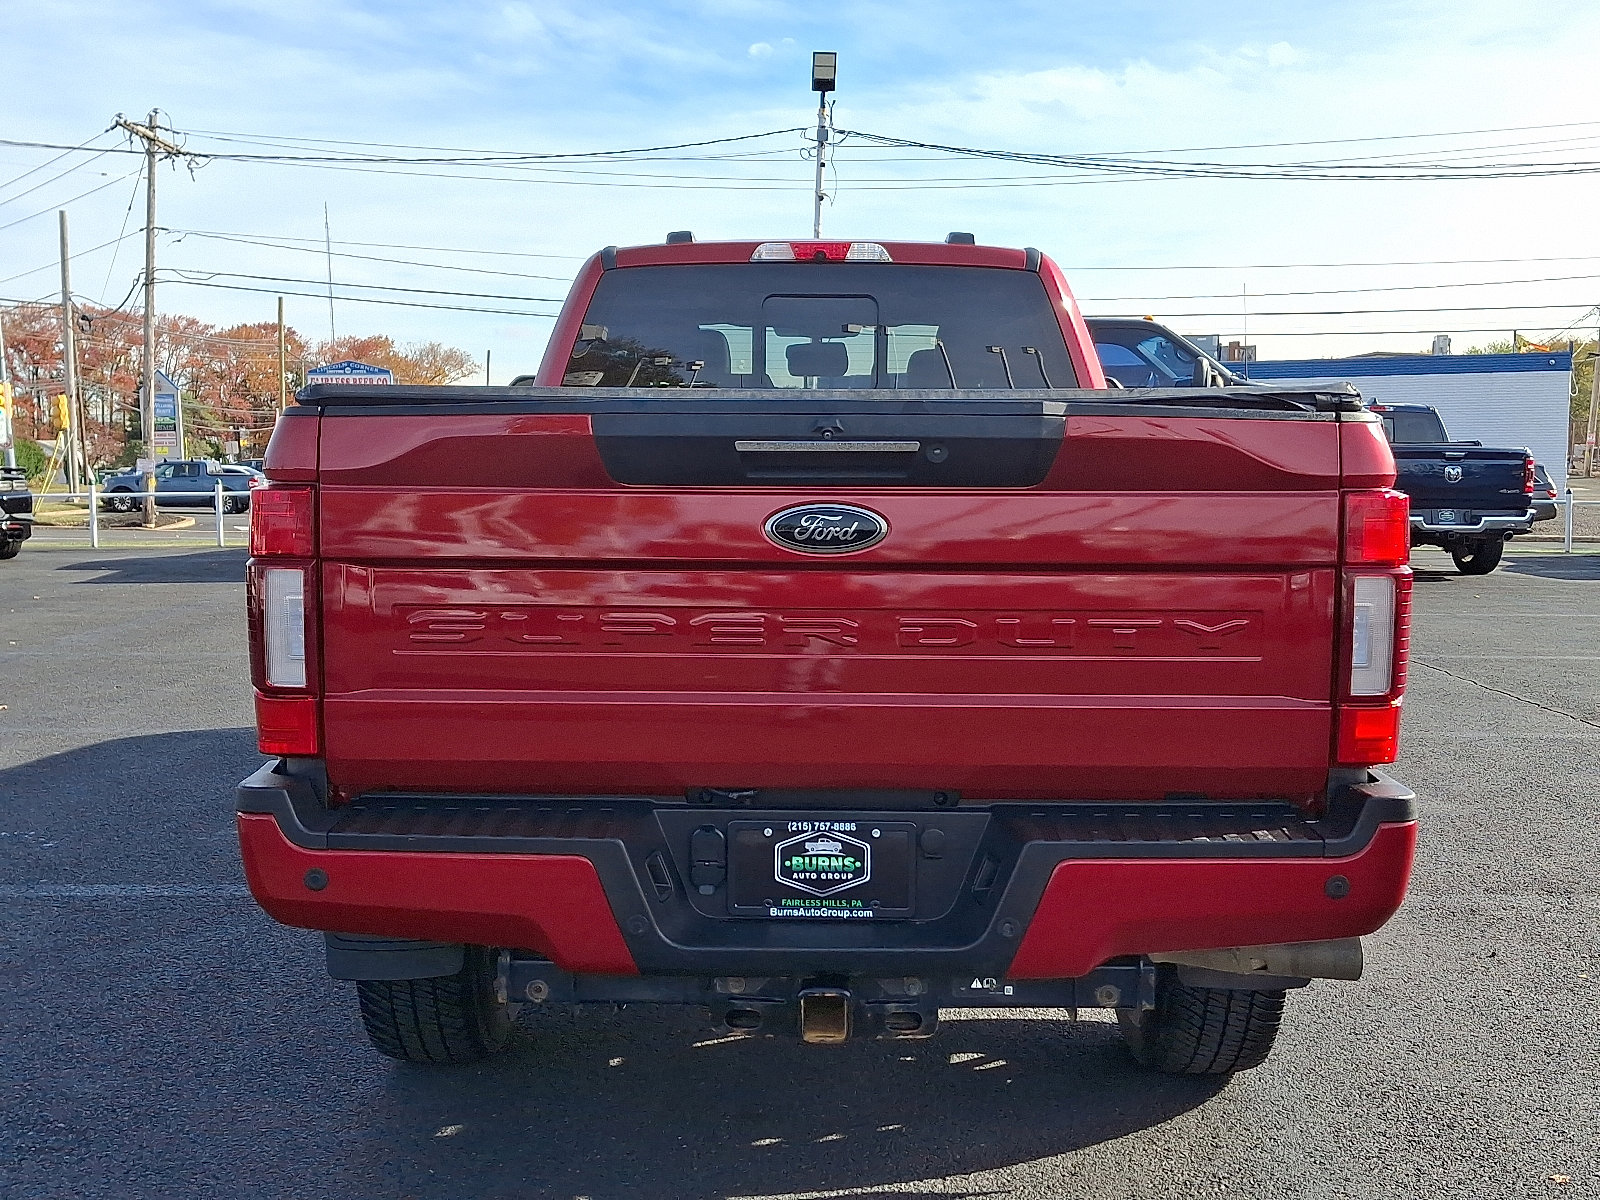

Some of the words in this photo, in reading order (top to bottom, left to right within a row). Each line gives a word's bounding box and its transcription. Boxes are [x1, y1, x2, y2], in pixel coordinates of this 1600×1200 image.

[316, 362, 348, 373] LINCOLN
[349, 362, 379, 373] CORNER
[794, 514, 859, 541] Ford
[406, 609, 860, 647] SUPER
[895, 617, 1250, 650] DUTY
[787, 821, 812, 832] (215)
[791, 856, 856, 872] BURNS
[792, 872, 818, 880] AUTO
[820, 872, 854, 880] GROUP
[781, 898, 821, 907] FAIRLESS
[822, 899, 850, 908] HILLS,
[851, 899, 863, 908] PA
[769, 907, 874, 919] BurnsAutoGroup.com
